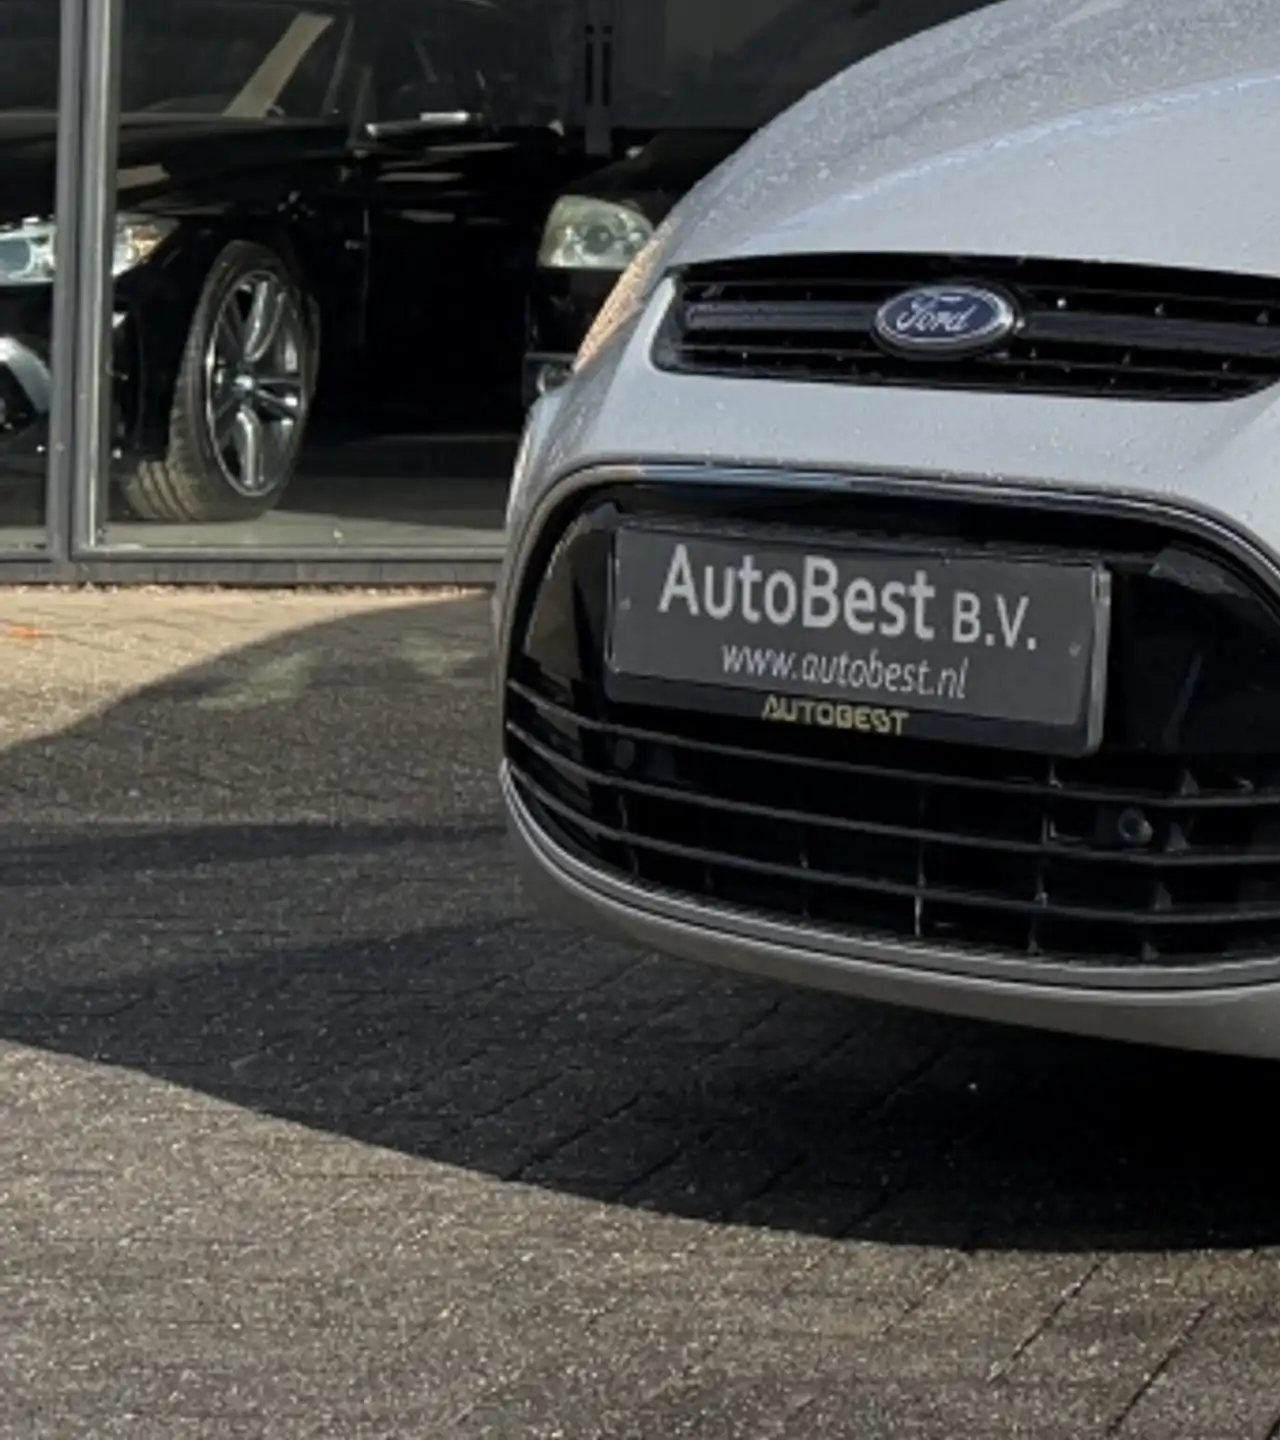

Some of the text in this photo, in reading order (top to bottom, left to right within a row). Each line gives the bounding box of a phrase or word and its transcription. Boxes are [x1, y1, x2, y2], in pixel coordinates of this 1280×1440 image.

[896, 296, 978, 332] Ford
[657, 543, 1038, 651] AutoBest B.V.
[721, 642, 970, 700] www.autobest.nl
[760, 693, 910, 736] AUTOBEST
